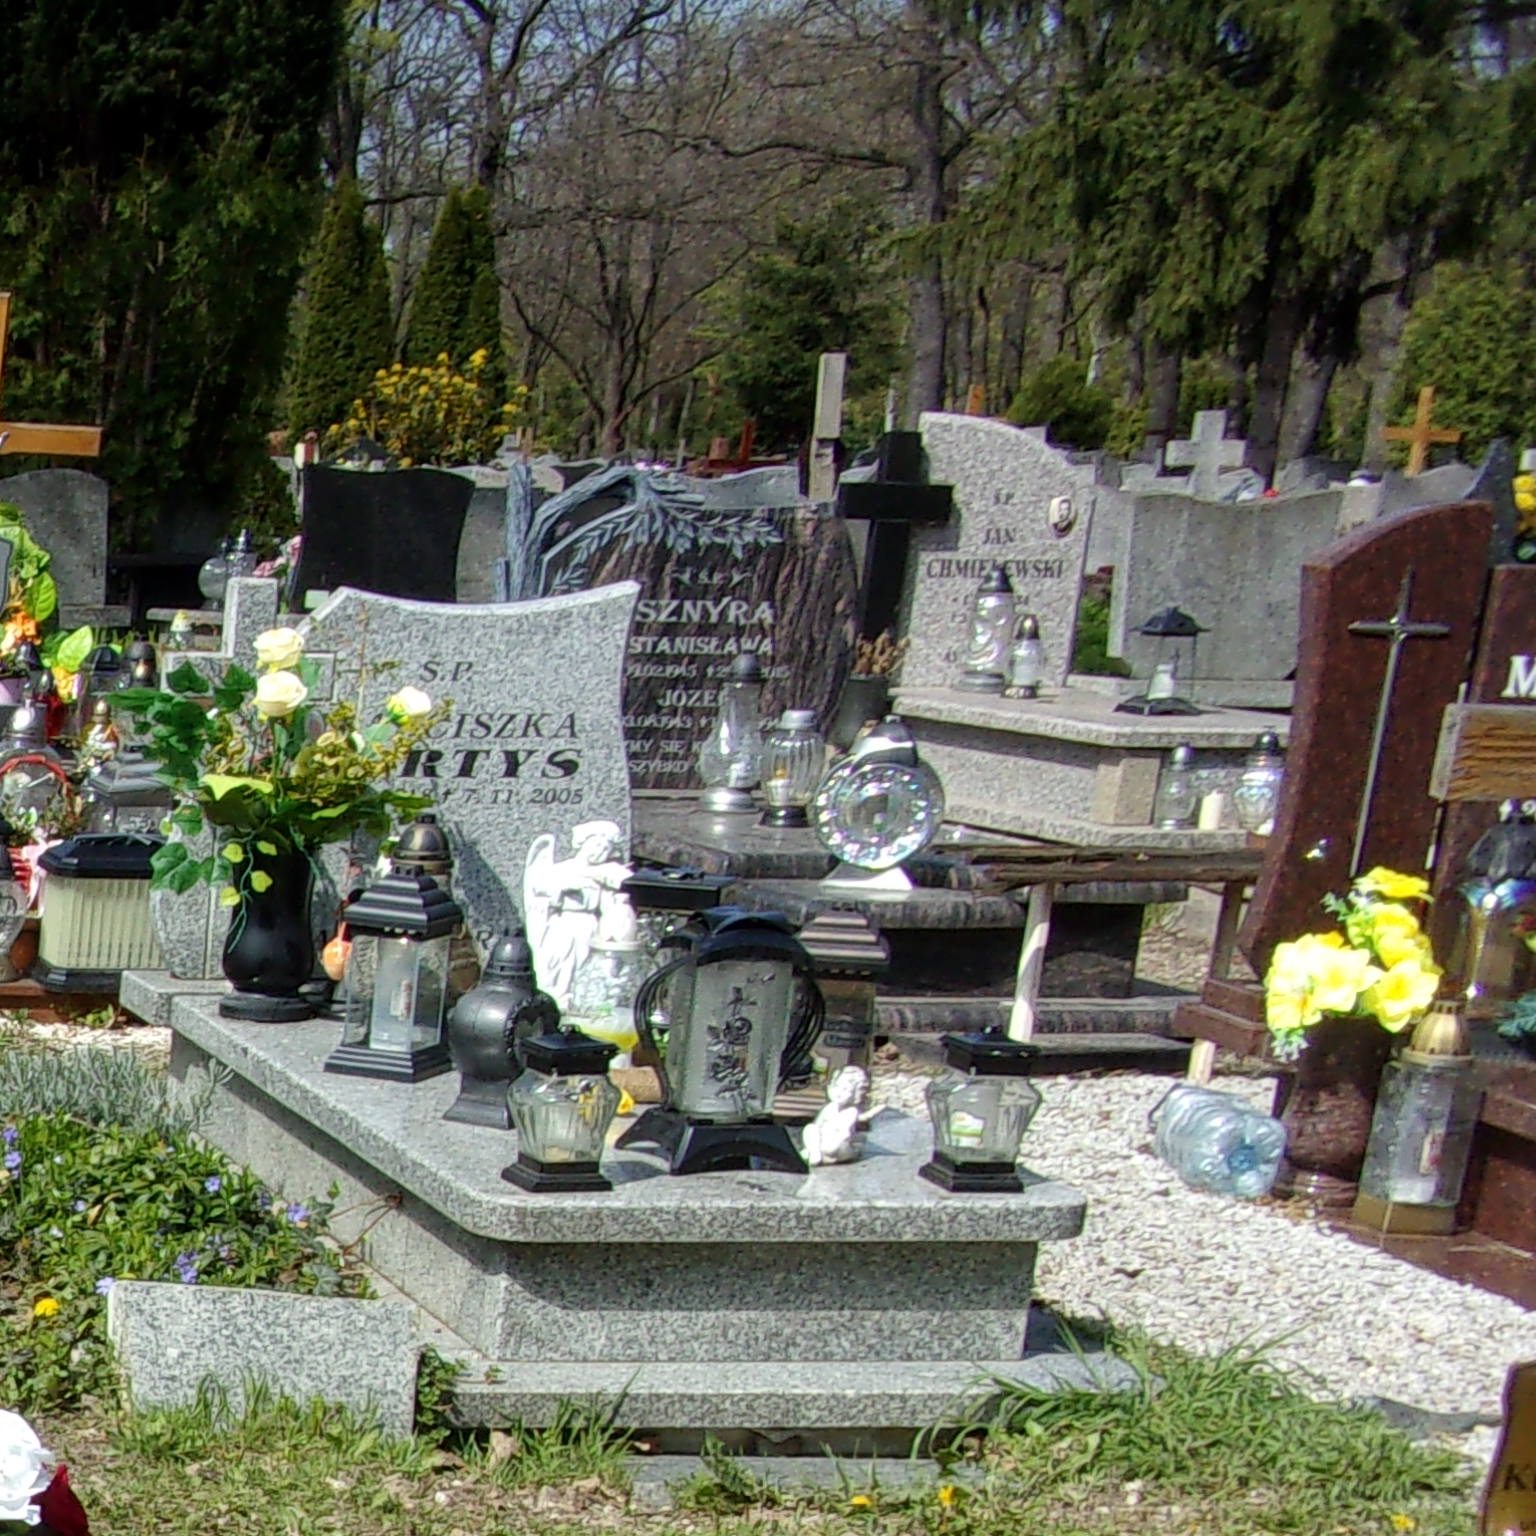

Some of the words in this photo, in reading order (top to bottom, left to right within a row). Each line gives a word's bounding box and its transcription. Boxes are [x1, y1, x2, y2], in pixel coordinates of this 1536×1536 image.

[981, 527, 1016, 545] JAN
[634, 596, 776, 625] SZNYRA
[428, 712, 579, 740] CISZKA
[398, 748, 583, 780] RTYS
[528, 788, 584, 806] 2005
